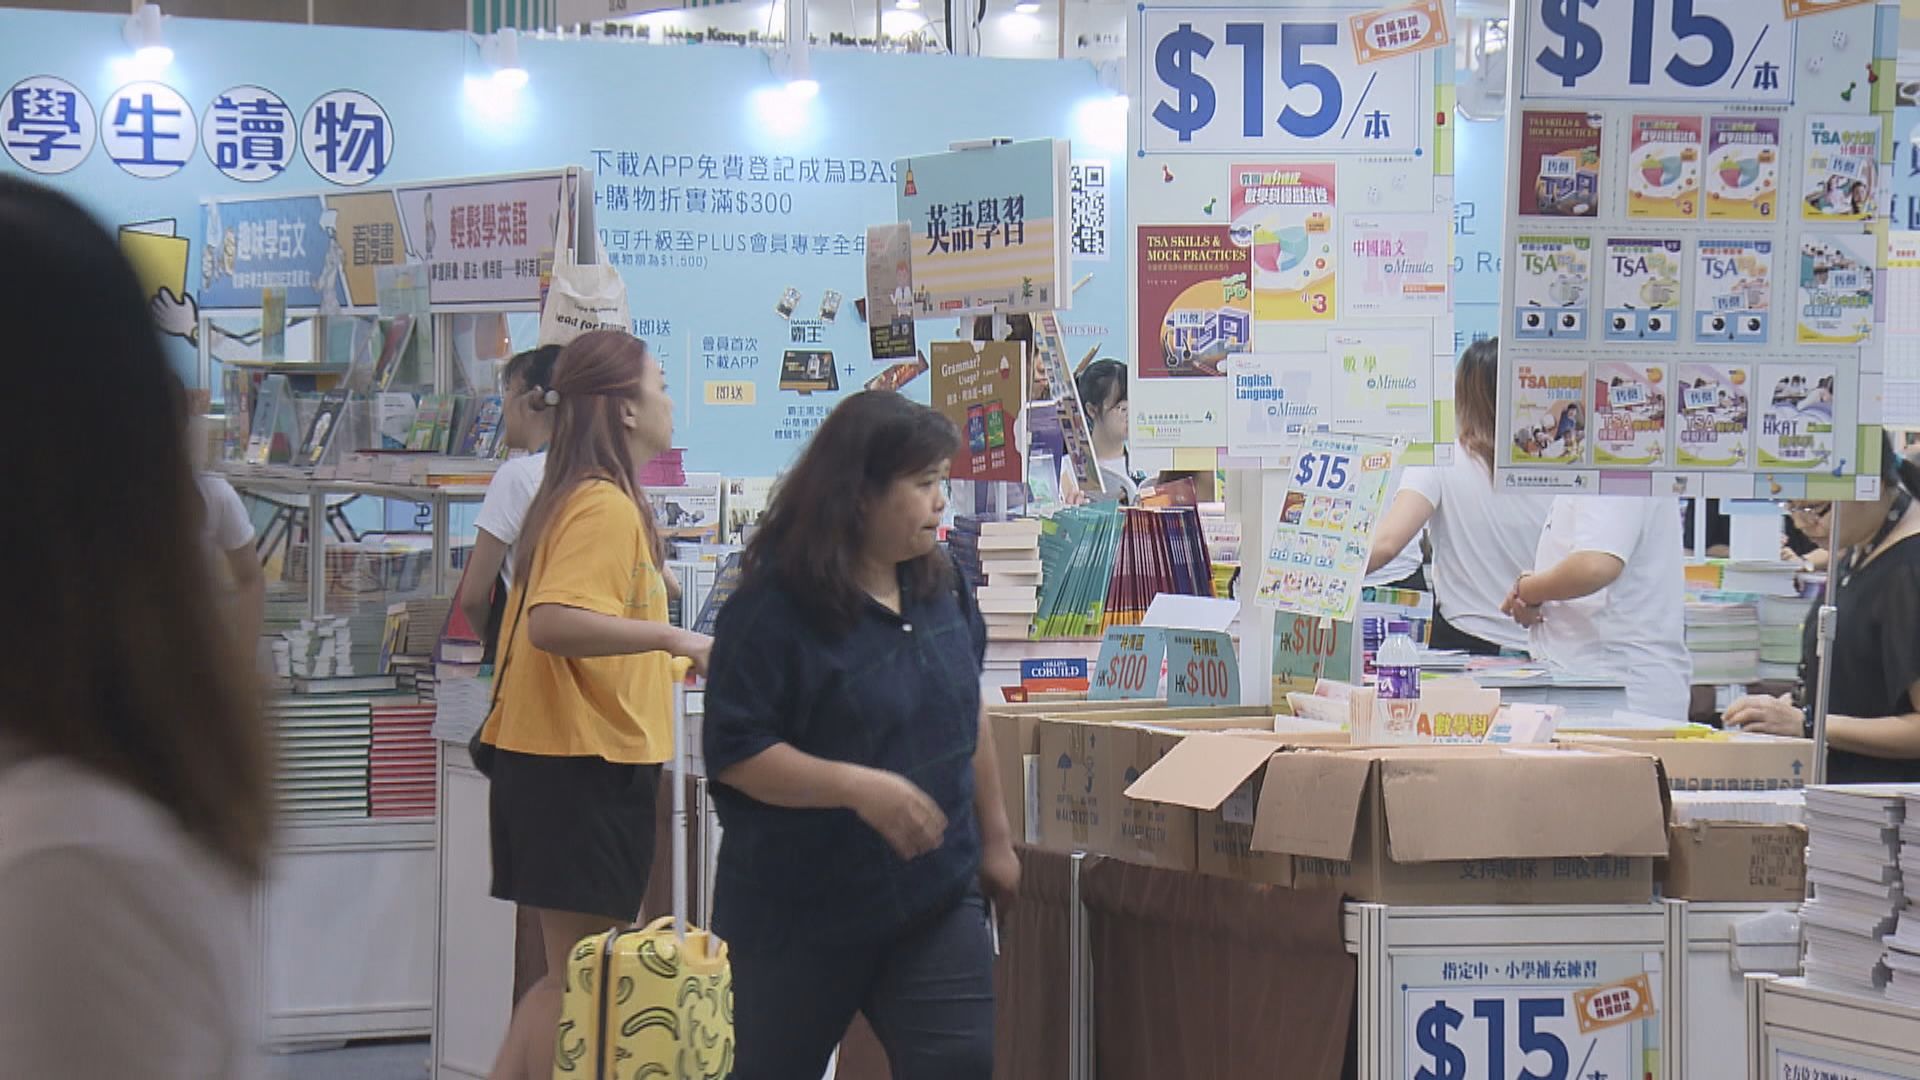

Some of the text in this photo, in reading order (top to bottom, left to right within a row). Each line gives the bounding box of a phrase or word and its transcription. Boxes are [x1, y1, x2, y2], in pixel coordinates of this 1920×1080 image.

[707, 28, 746, 45] Kong
[1153, 23, 1390, 141] $15/本
[7, 87, 385, 176] 學生讀物
[450, 201, 527, 249] 輕鬆學英語
[924, 193, 1026, 255] 英語學習
[1147, 236, 1221, 248] TSA SKILLS &
[1147, 250, 1247, 262] MOCK PRACTICES
[1521, 252, 1558, 275] TSA
[1612, 255, 1649, 278] TSA
[1701, 257, 1739, 279] TSA
[702, 336, 758, 352] 會員首次
[702, 353, 759, 370] 下載APP
[941, 354, 981, 377] Grammar?
[1236, 374, 1272, 388] English
[715, 385, 744, 401] 即送
[1236, 388, 1284, 401] Language
[1763, 421, 1799, 435] HKAT
[1031, 666, 1080, 678] COBUILD
